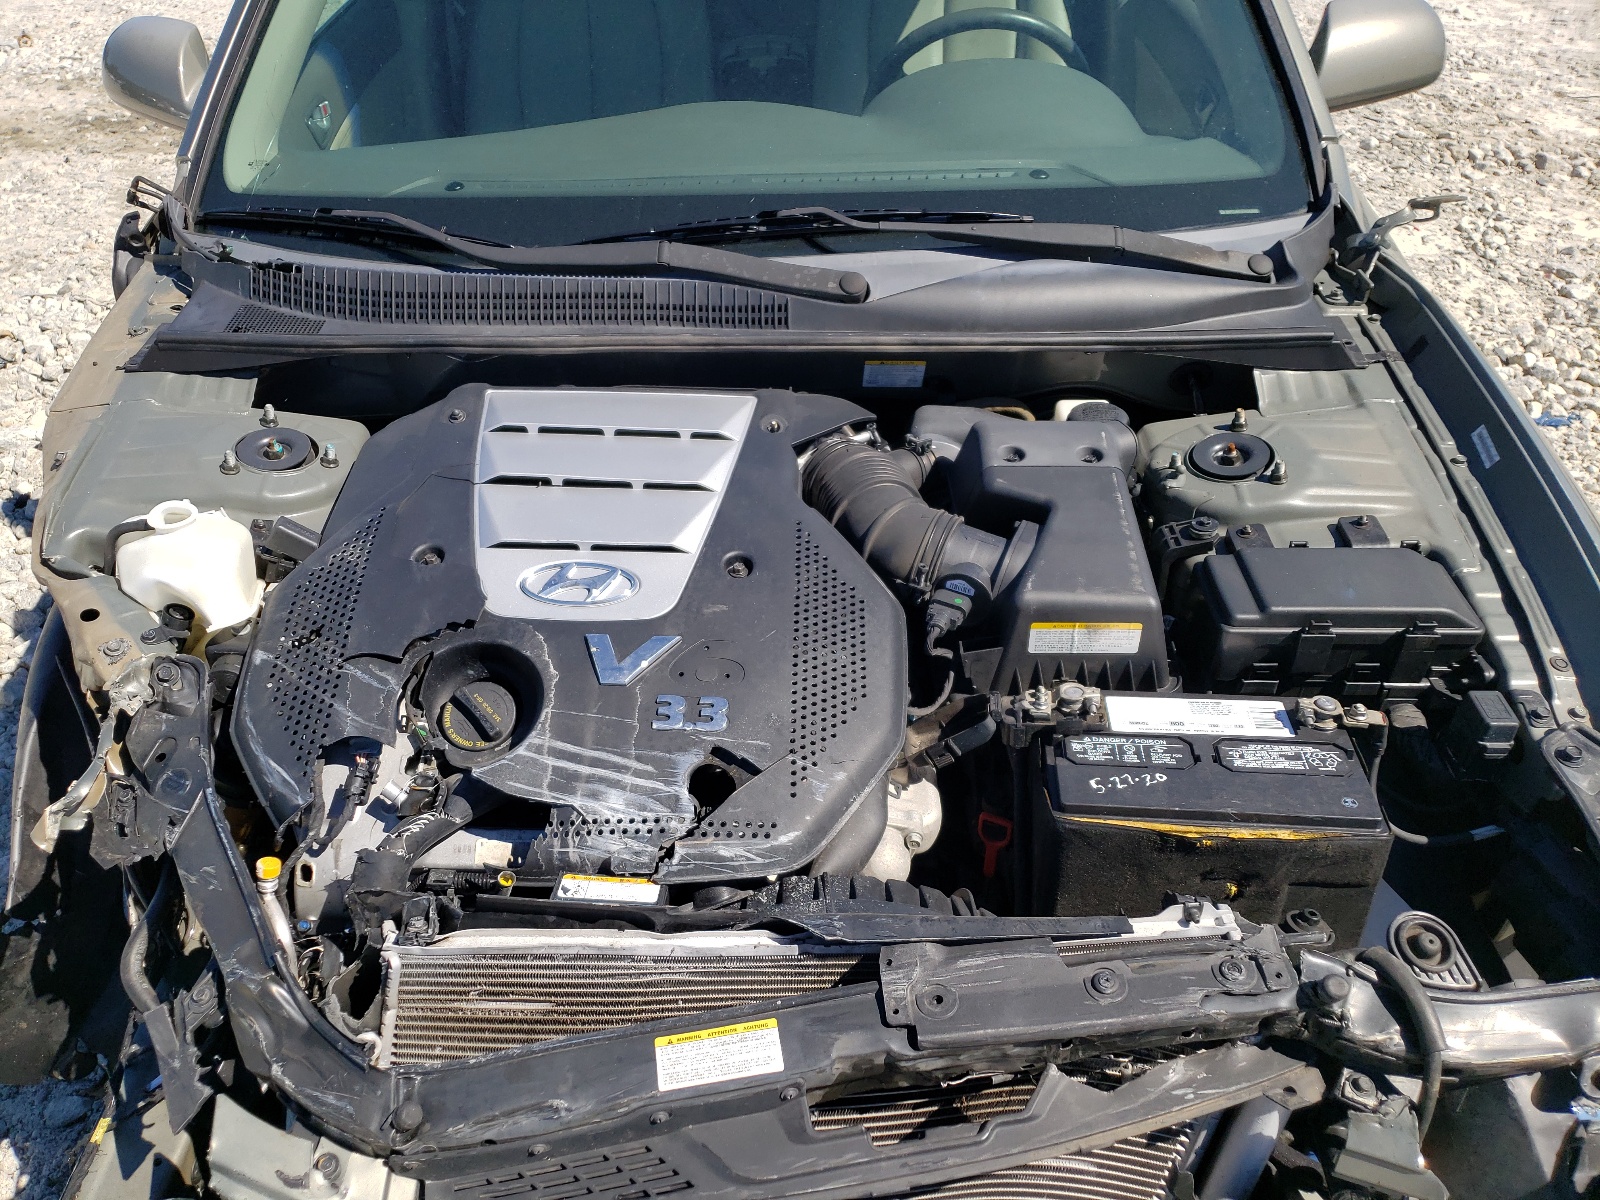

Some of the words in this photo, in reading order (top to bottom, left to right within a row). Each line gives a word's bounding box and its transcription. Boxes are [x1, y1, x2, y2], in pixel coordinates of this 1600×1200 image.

[676, 1034, 702, 1042] WARNING
[707, 1028, 738, 1037] ATTENTION
[742, 1022, 769, 1031] ACHTUNG
